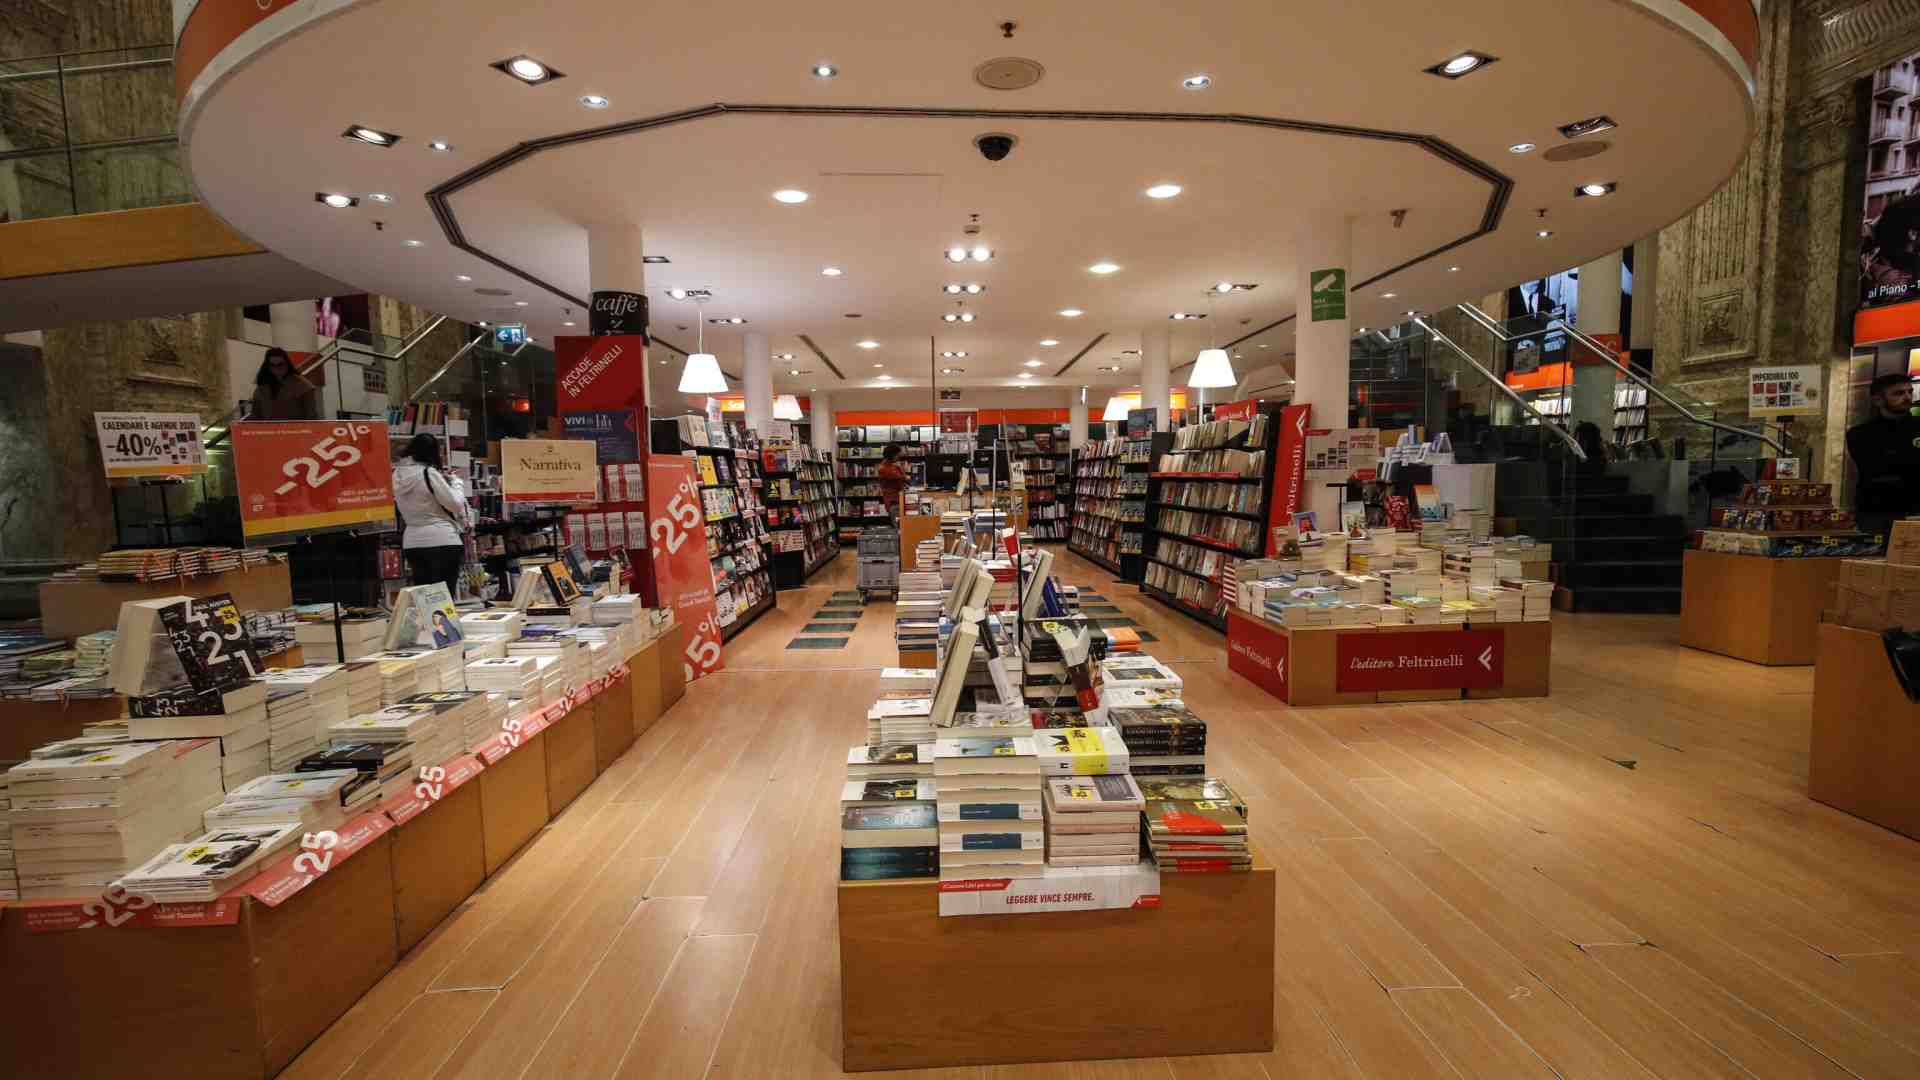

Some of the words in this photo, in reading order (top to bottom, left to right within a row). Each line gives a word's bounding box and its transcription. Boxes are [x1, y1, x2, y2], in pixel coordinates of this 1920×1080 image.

[1867, 287, 1877, 299] al
[1880, 285, 1908, 297] Piano
[561, 355, 594, 390] ACCADE
[568, 384, 581, 398] IN
[578, 344, 624, 389] FELTRINELLI
[102, 421, 143, 431] CALENDARI
[106, 433, 162, 456] -40%
[273, 422, 371, 496] -25%
[520, 458, 582, 471] Narrativa
[1399, 654, 1464, 668] Feltrinelli
[1006, 895, 1038, 905] LEGGERE
[1040, 893, 1061, 904] VINCE
[1063, 892, 1096, 903] SEMPRE.
